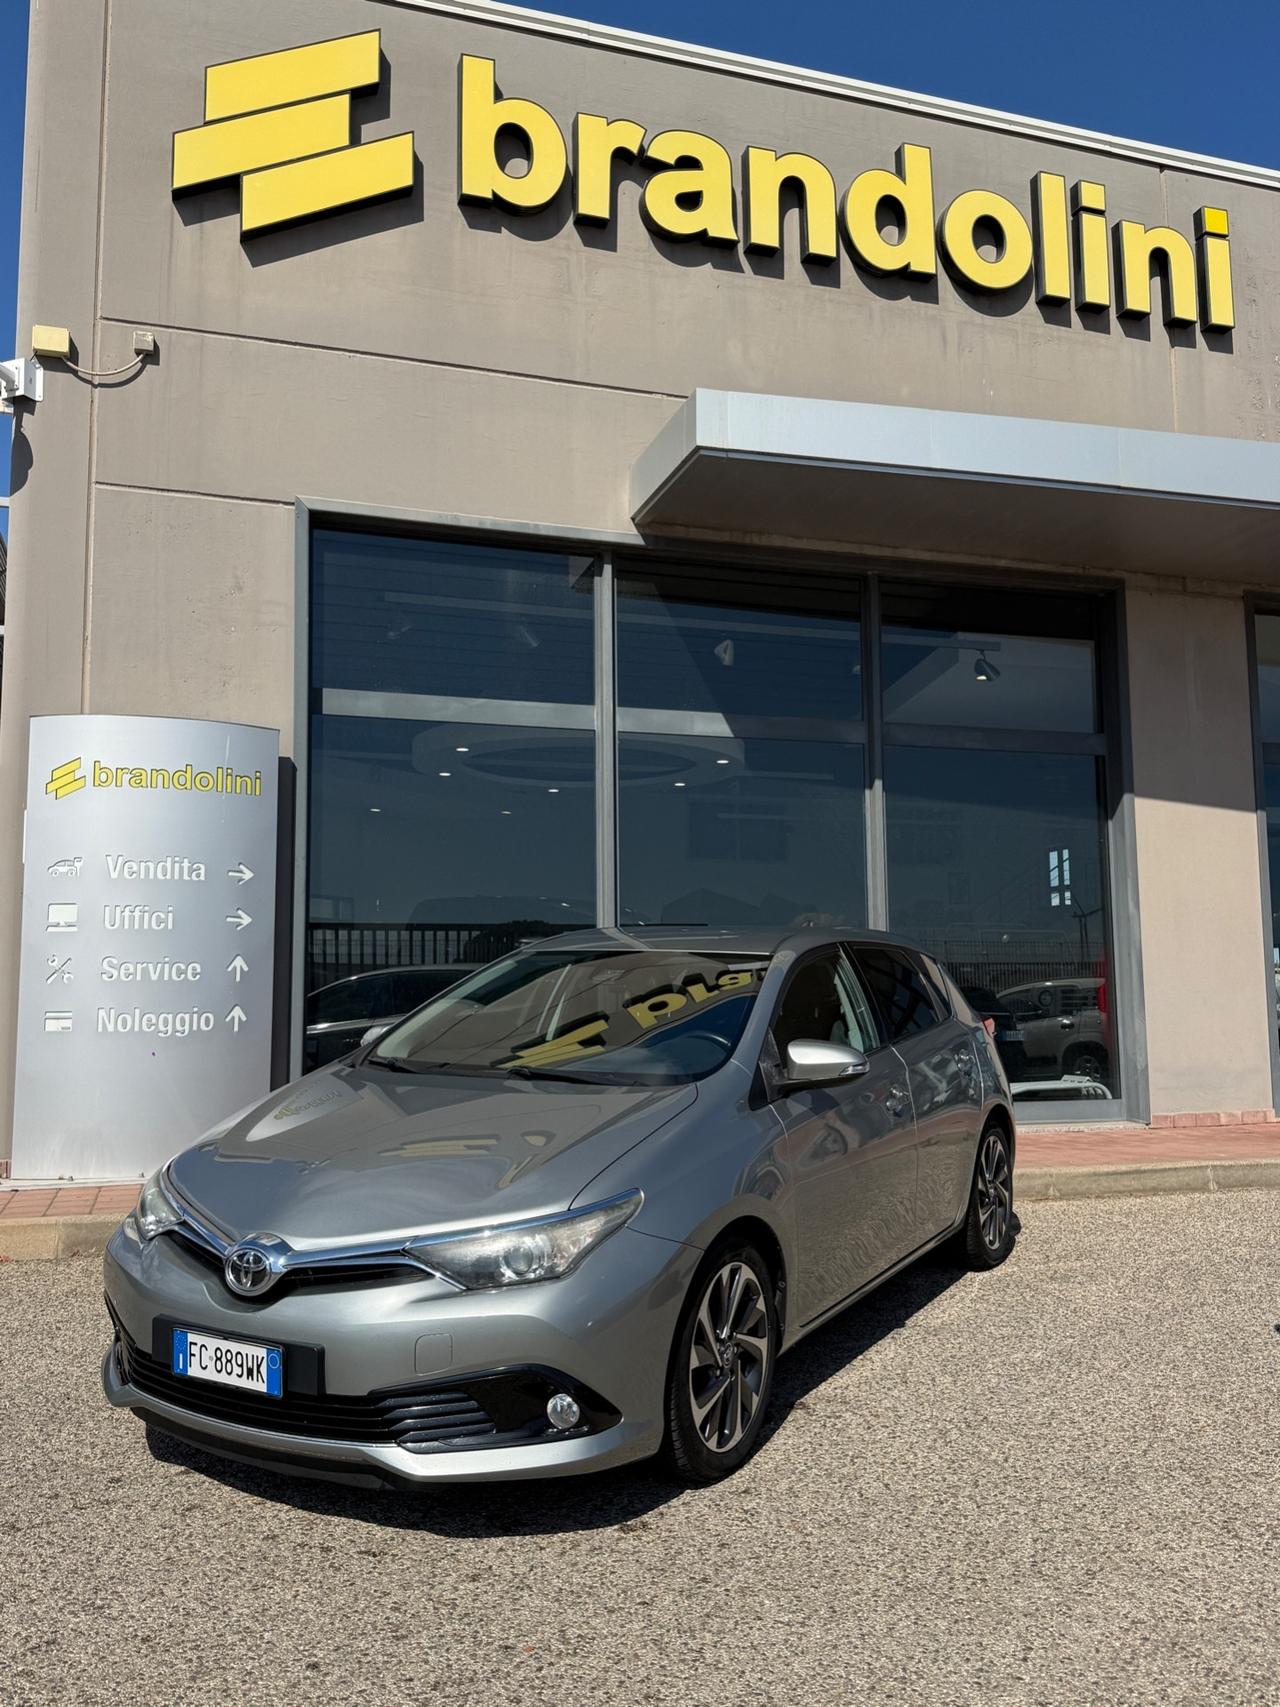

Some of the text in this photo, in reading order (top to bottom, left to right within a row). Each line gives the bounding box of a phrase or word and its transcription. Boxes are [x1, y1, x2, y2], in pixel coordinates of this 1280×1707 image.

[458, 53, 1235, 333] brandolini
[92, 760, 262, 797] brandolini
[105, 855, 206, 882] Vendita
[103, 904, 174, 931] Uffici
[101, 955, 202, 982] Service
[96, 1006, 215, 1037] Noleggio
